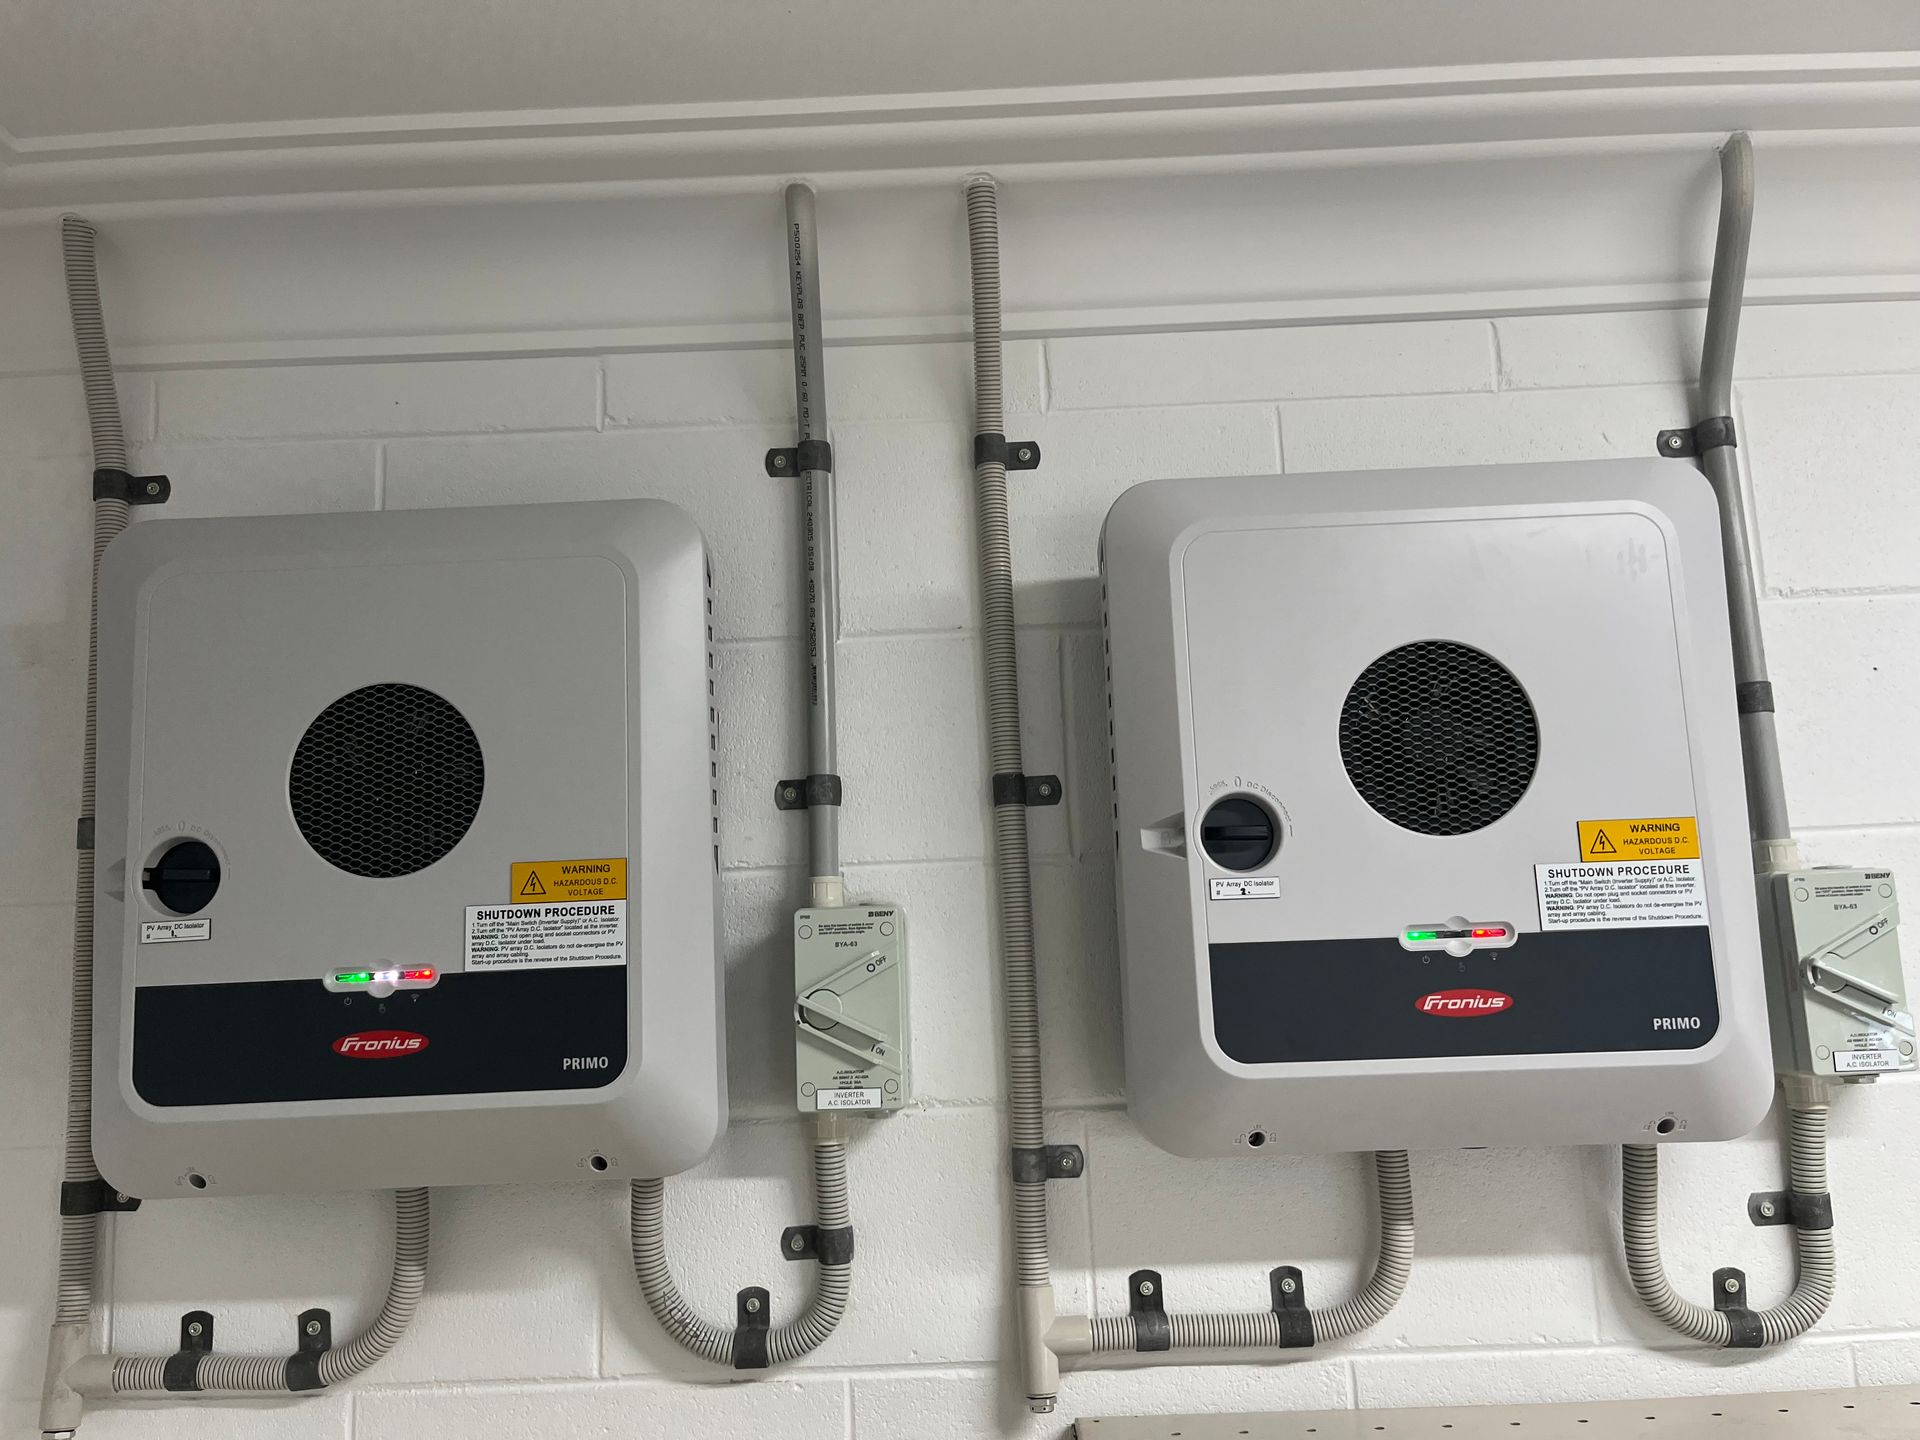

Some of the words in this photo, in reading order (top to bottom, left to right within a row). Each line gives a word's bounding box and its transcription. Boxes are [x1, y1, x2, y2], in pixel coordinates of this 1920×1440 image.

[795, 271, 804, 309] KEYPLAS
[1630, 823, 1680, 833] WARNING
[1623, 837, 1673, 845] HAZARDOUS
[1674, 836, 1689, 844] D.C.
[1639, 847, 1676, 855] VOLTAGE
[562, 864, 611, 875] WARNING
[1548, 867, 1614, 878] SHUTDOWN
[1618, 864, 1690, 876] PROCEDURE
[553, 878, 602, 887] HAZARDOUS
[568, 888, 604, 896] VOLTAGE
[477, 908, 541, 920] SHUTDOWN
[545, 905, 615, 918] PROCEDURE
[1877, 917, 1888, 929] OFF
[157, 924, 172, 933] Array
[875, 956, 886, 966] OFF
[1423, 995, 1505, 1010] Fronius
[1887, 1009, 1896, 1018] ON
[1653, 1016, 1701, 1030] PRIMO
[340, 1037, 422, 1052] Fronius
[875, 1047, 886, 1056] ON
[563, 1056, 609, 1070] PRIMO
